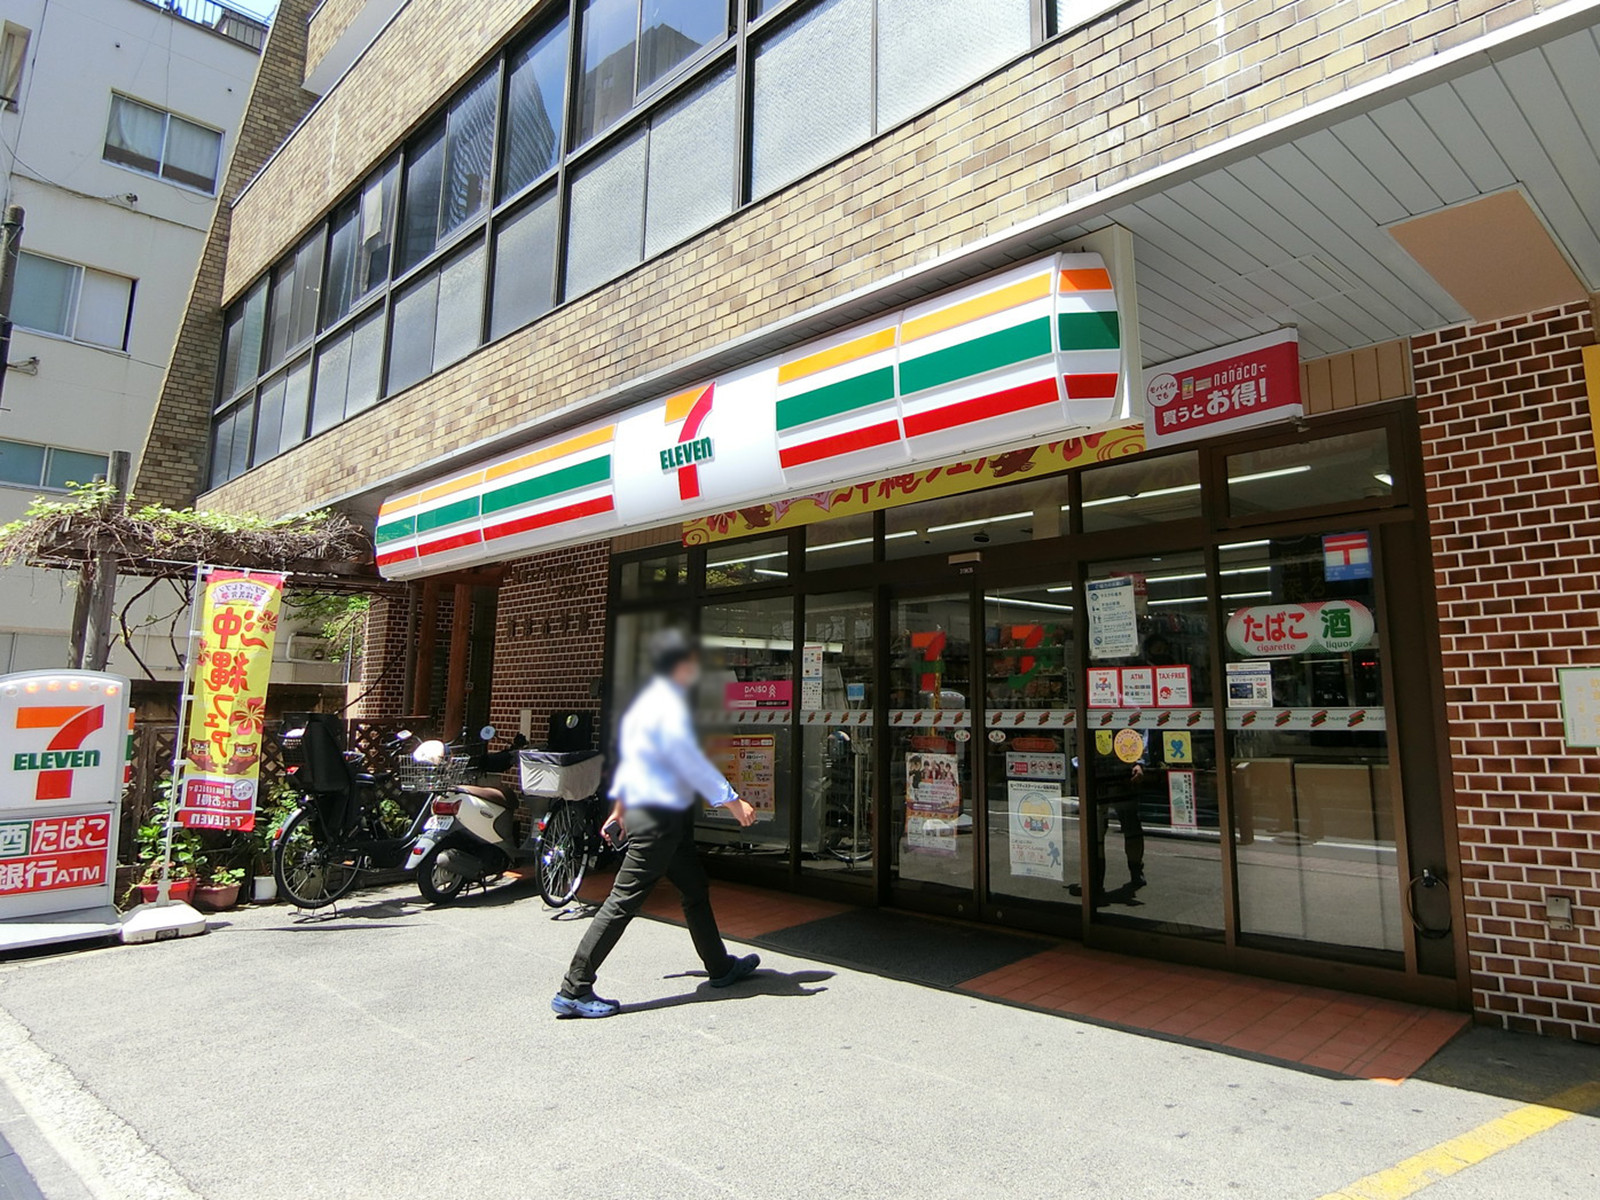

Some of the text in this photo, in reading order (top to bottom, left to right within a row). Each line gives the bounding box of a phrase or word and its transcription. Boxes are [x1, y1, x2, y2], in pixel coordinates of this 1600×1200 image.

[1150, 382, 1176, 394] モバイル
[1156, 393, 1170, 402] でも
[1243, 610, 1308, 643] たばこ
[1321, 607, 1352, 638] 酒
[1257, 643, 1296, 653] cigarette
[1326, 640, 1354, 650] liquor
[1130, 673, 1144, 681] ATM
[1158, 672, 1186, 680] TAX-FREE
[744, 685, 768, 693] DAISO
[33, 818, 107, 853] たばこ
